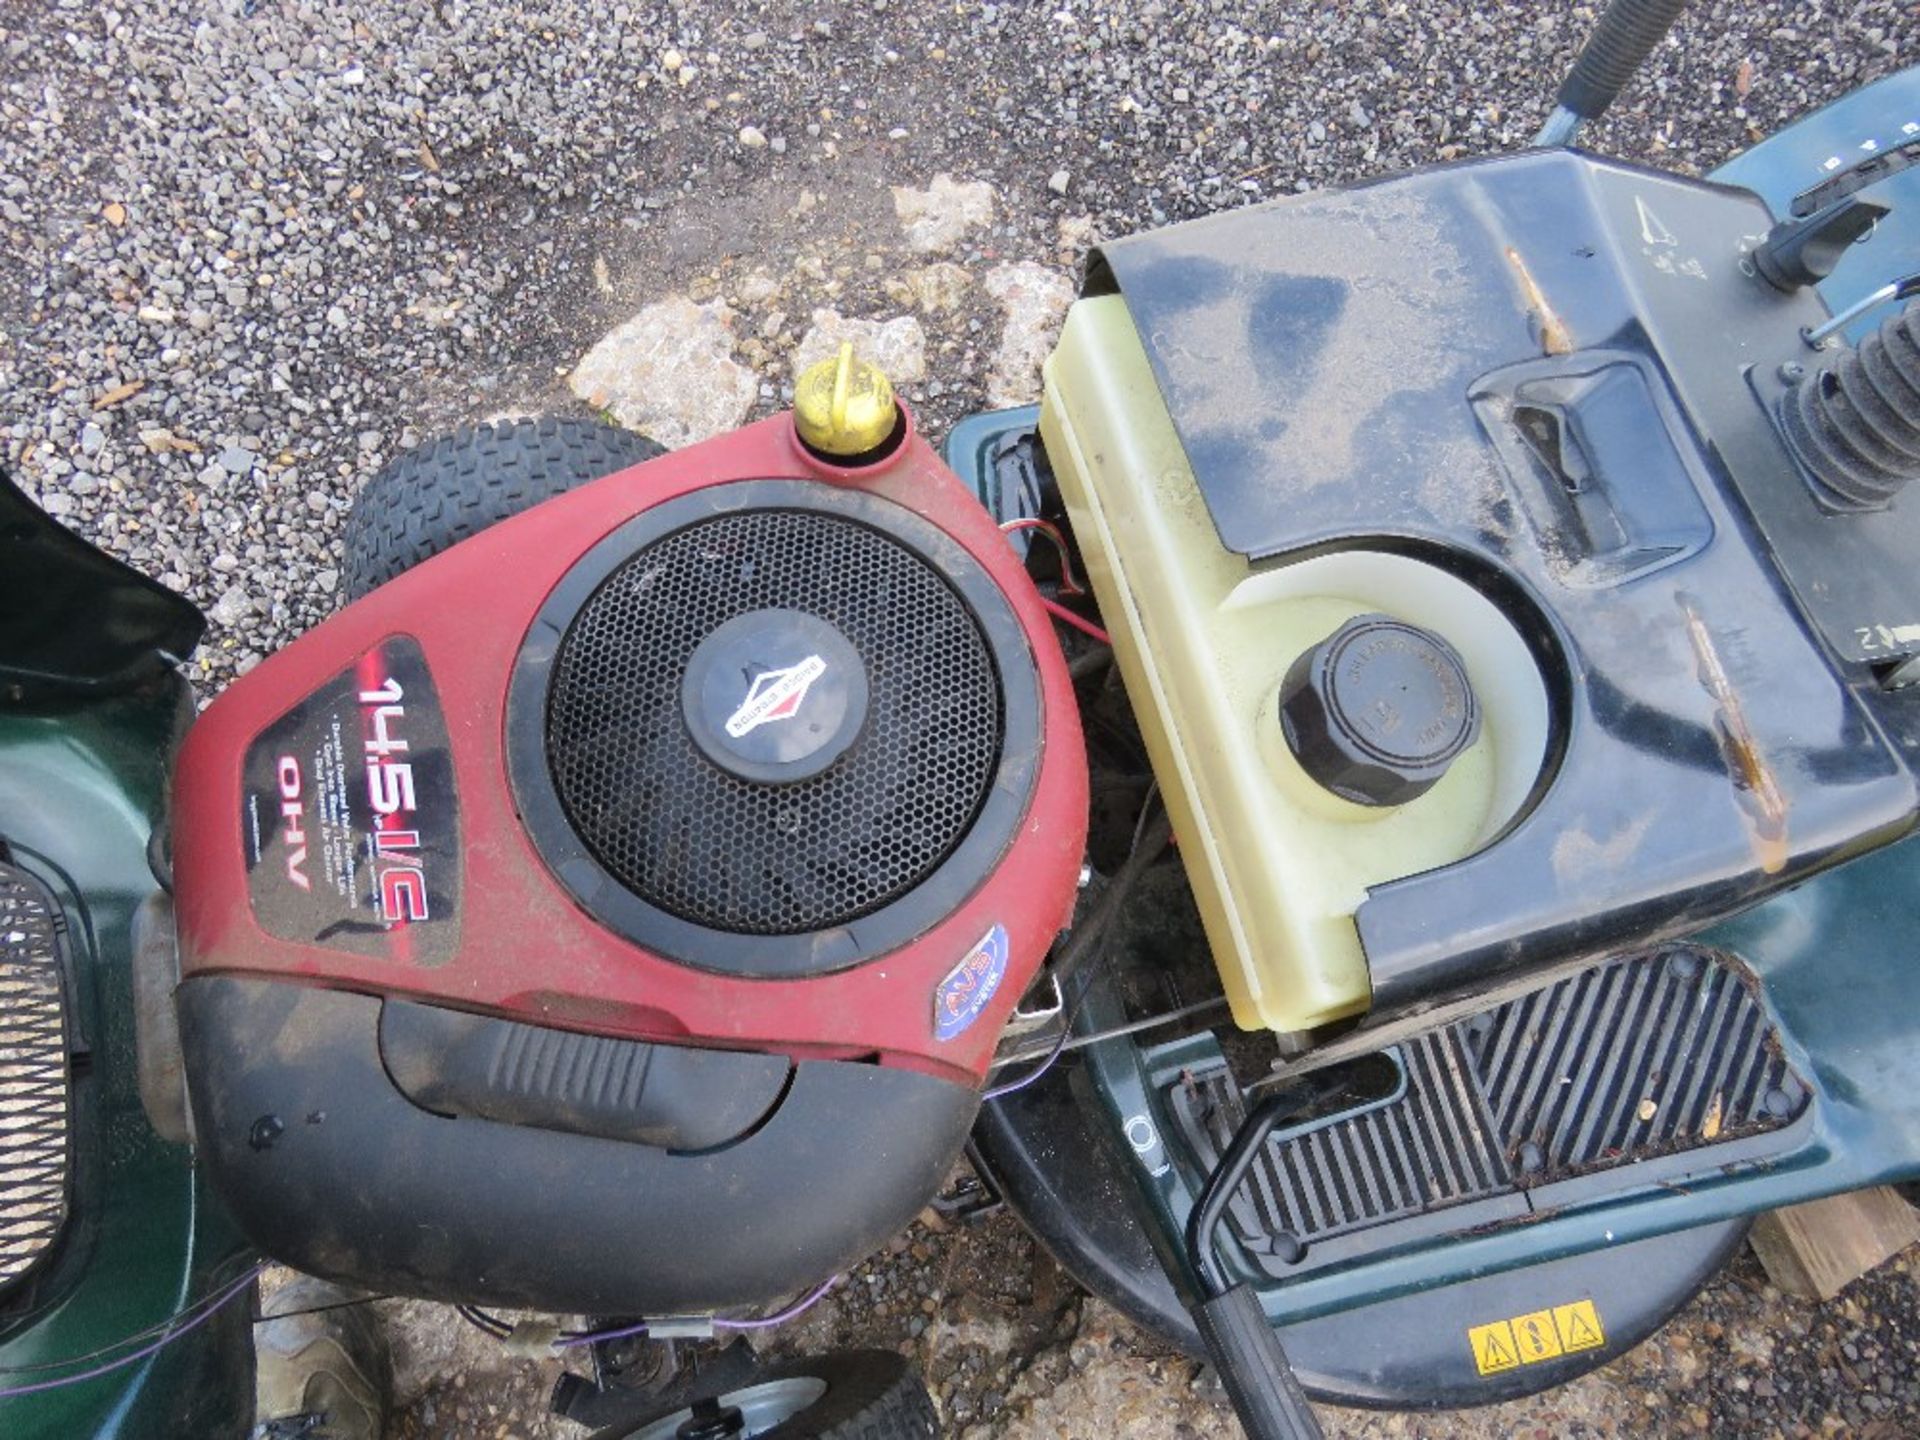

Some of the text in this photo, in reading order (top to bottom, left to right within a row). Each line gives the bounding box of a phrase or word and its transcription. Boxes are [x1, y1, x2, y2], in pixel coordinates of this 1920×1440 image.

[336, 763, 348, 809] Overhead
[359, 677, 416, 813] 14.5
[278, 756, 310, 891] OHV
[376, 830, 428, 920] I/C
